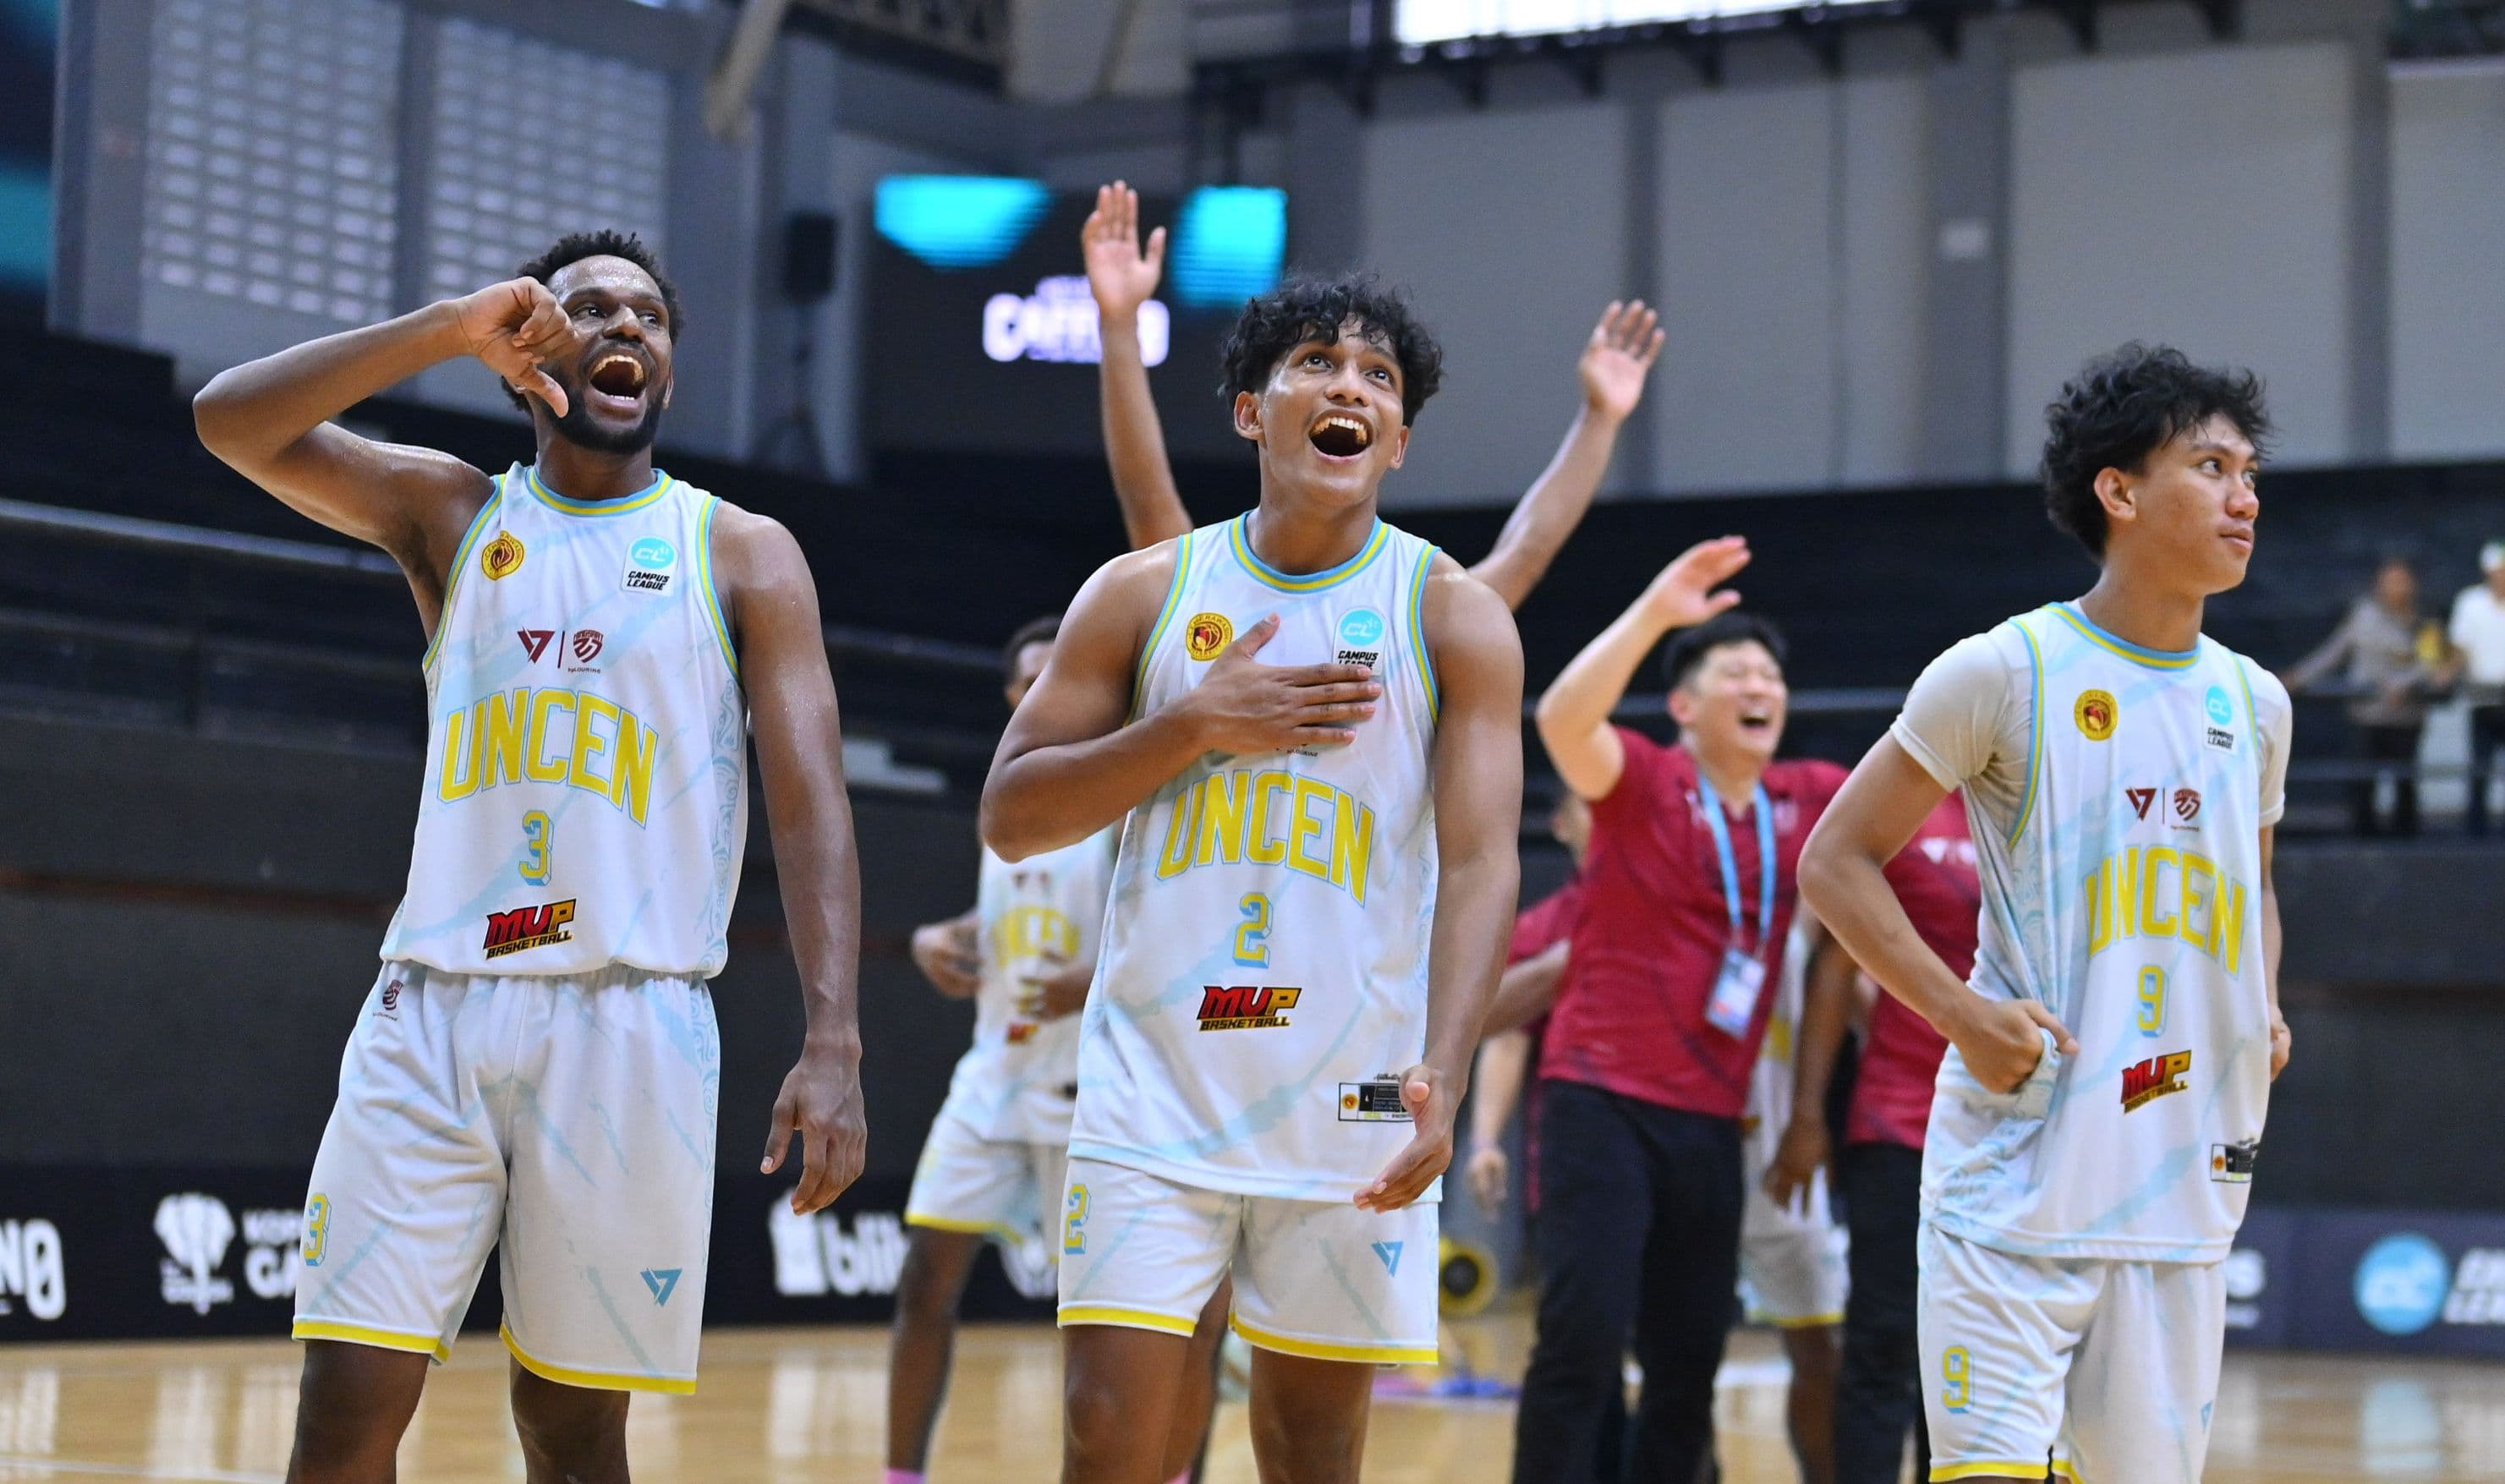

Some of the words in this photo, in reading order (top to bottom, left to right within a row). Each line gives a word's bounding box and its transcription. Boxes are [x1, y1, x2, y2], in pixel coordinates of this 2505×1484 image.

[627, 578, 666, 591] LEAGUE
[628, 570, 670, 583] CAMPUS
[1338, 650, 1379, 661] CAMPUS
[437, 687, 658, 829] UNCEN
[518, 810, 555, 886] 3
[1155, 769, 1375, 908] UNCEN
[483, 898, 577, 950] MVP
[486, 930, 573, 960] BASKETBALL
[1233, 892, 1273, 969] 2
[2085, 845, 2247, 979] UNCEN
[1197, 985, 1302, 1020] MVP
[1200, 1016, 1291, 1031] BASKETBALL
[2137, 965, 2169, 1038] 9
[2120, 1049, 2192, 1104] MVP
[302, 1193, 332, 1267] 3
[1064, 1184, 1092, 1255] 2
[1944, 1345, 1975, 1416] 9
